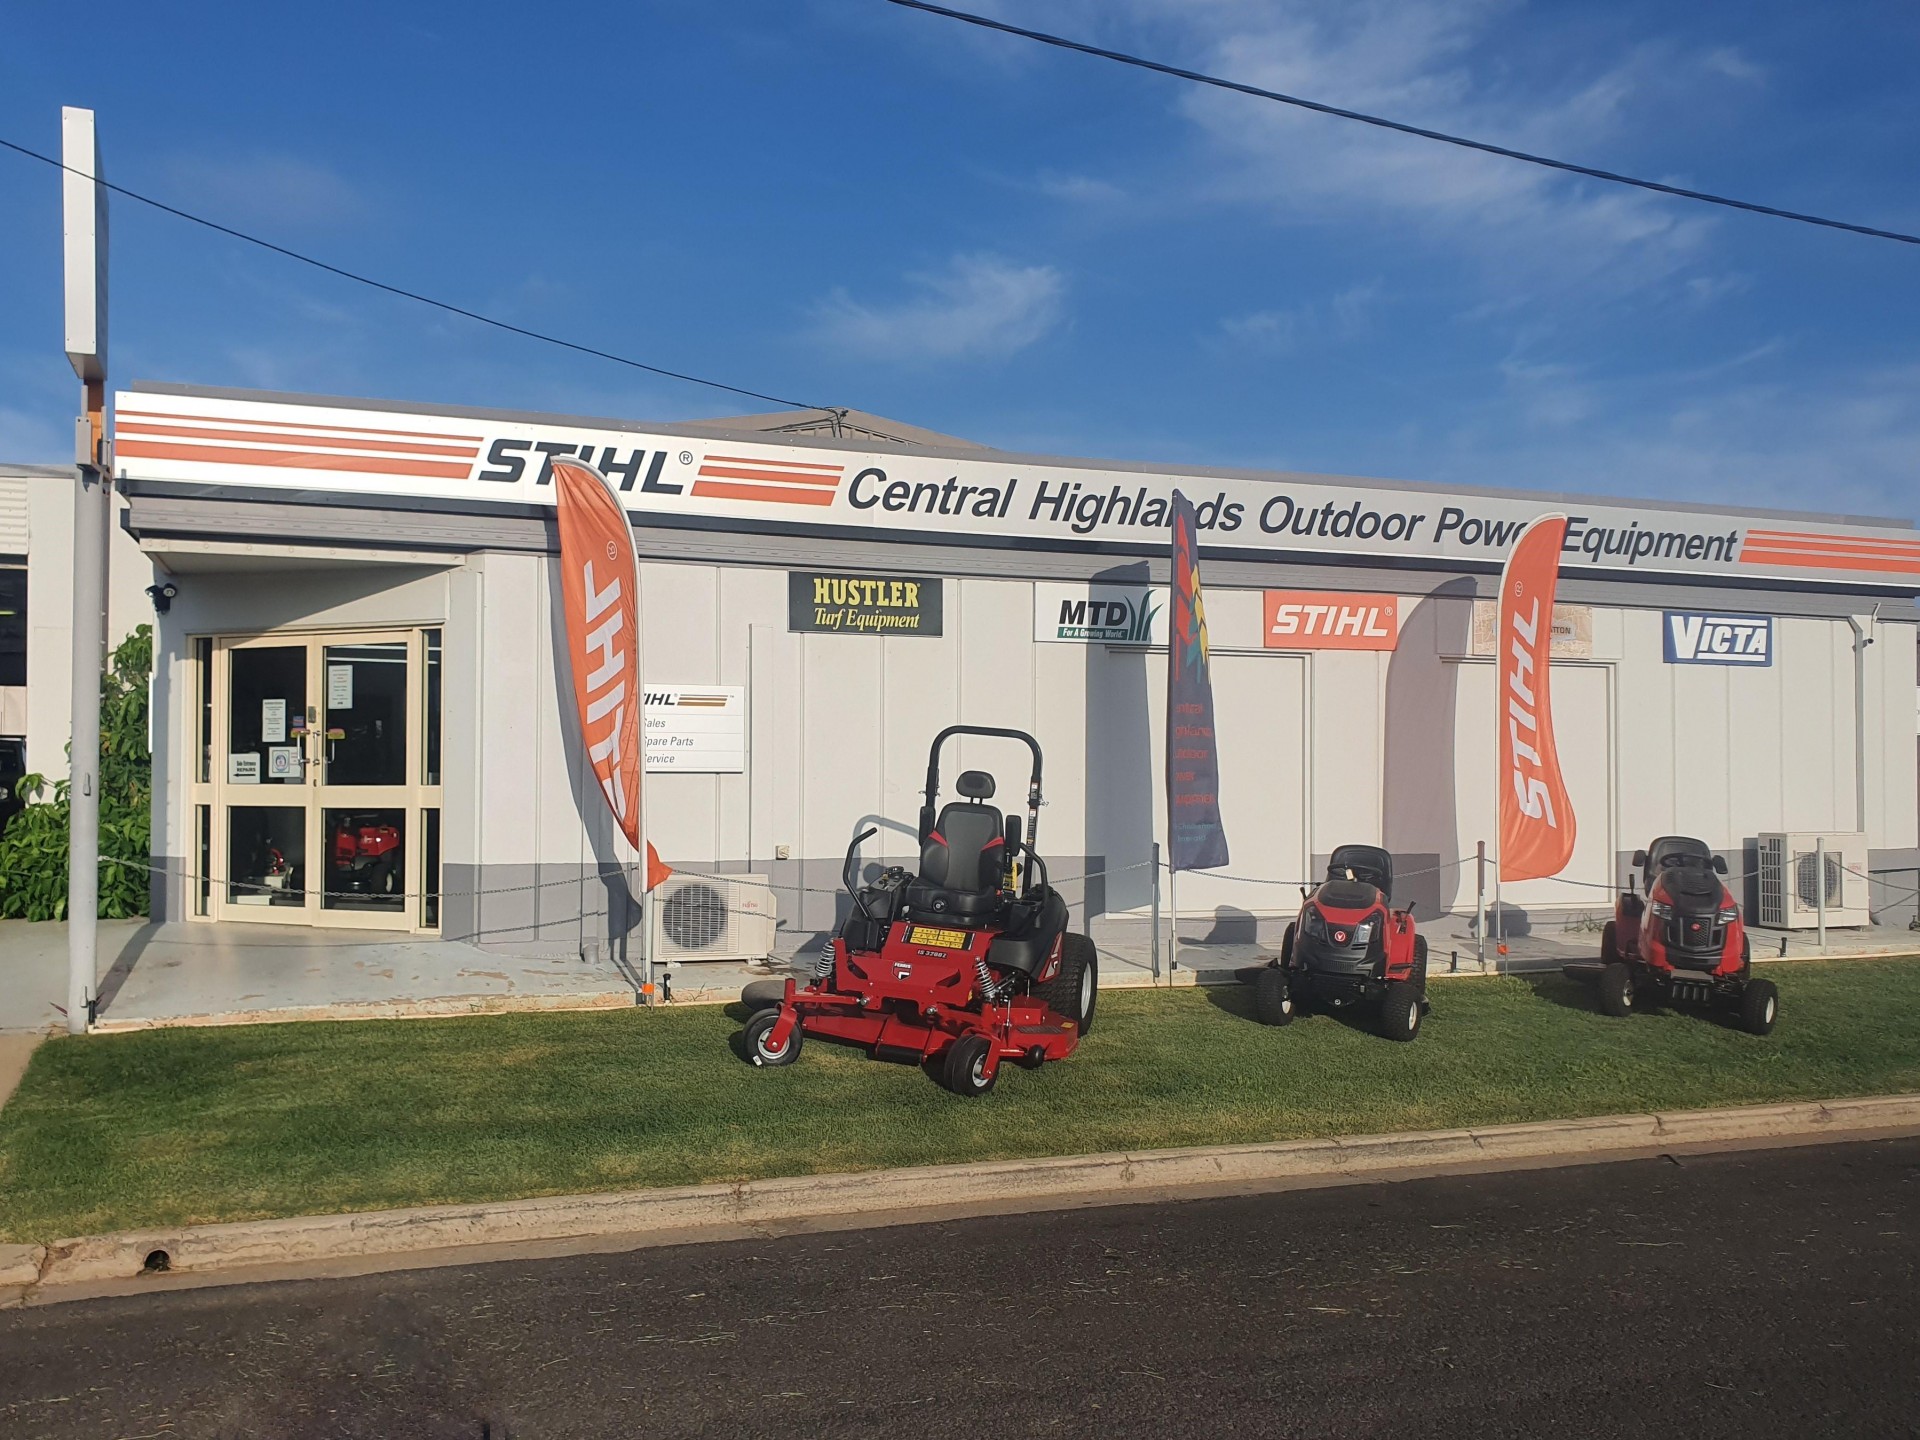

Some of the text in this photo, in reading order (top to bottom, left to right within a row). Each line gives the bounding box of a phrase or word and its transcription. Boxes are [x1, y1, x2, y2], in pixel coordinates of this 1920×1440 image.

[847, 467, 1738, 565] Central Highlads Outdoor Pow Equipment
[813, 578, 919, 608] HUSTLER
[814, 607, 920, 632] Turf Equipment
[1059, 600, 1128, 626] MTD
[1271, 604, 1388, 637] STIHL
[1063, 628, 1072, 637] For
[1074, 629, 1079, 637] A
[1080, 629, 1103, 639] Growing
[644, 693, 676, 706] IHL
[1509, 596, 1557, 829] STIHL
[670, 736, 694, 746] Parts
[645, 754, 675, 764] ervice
